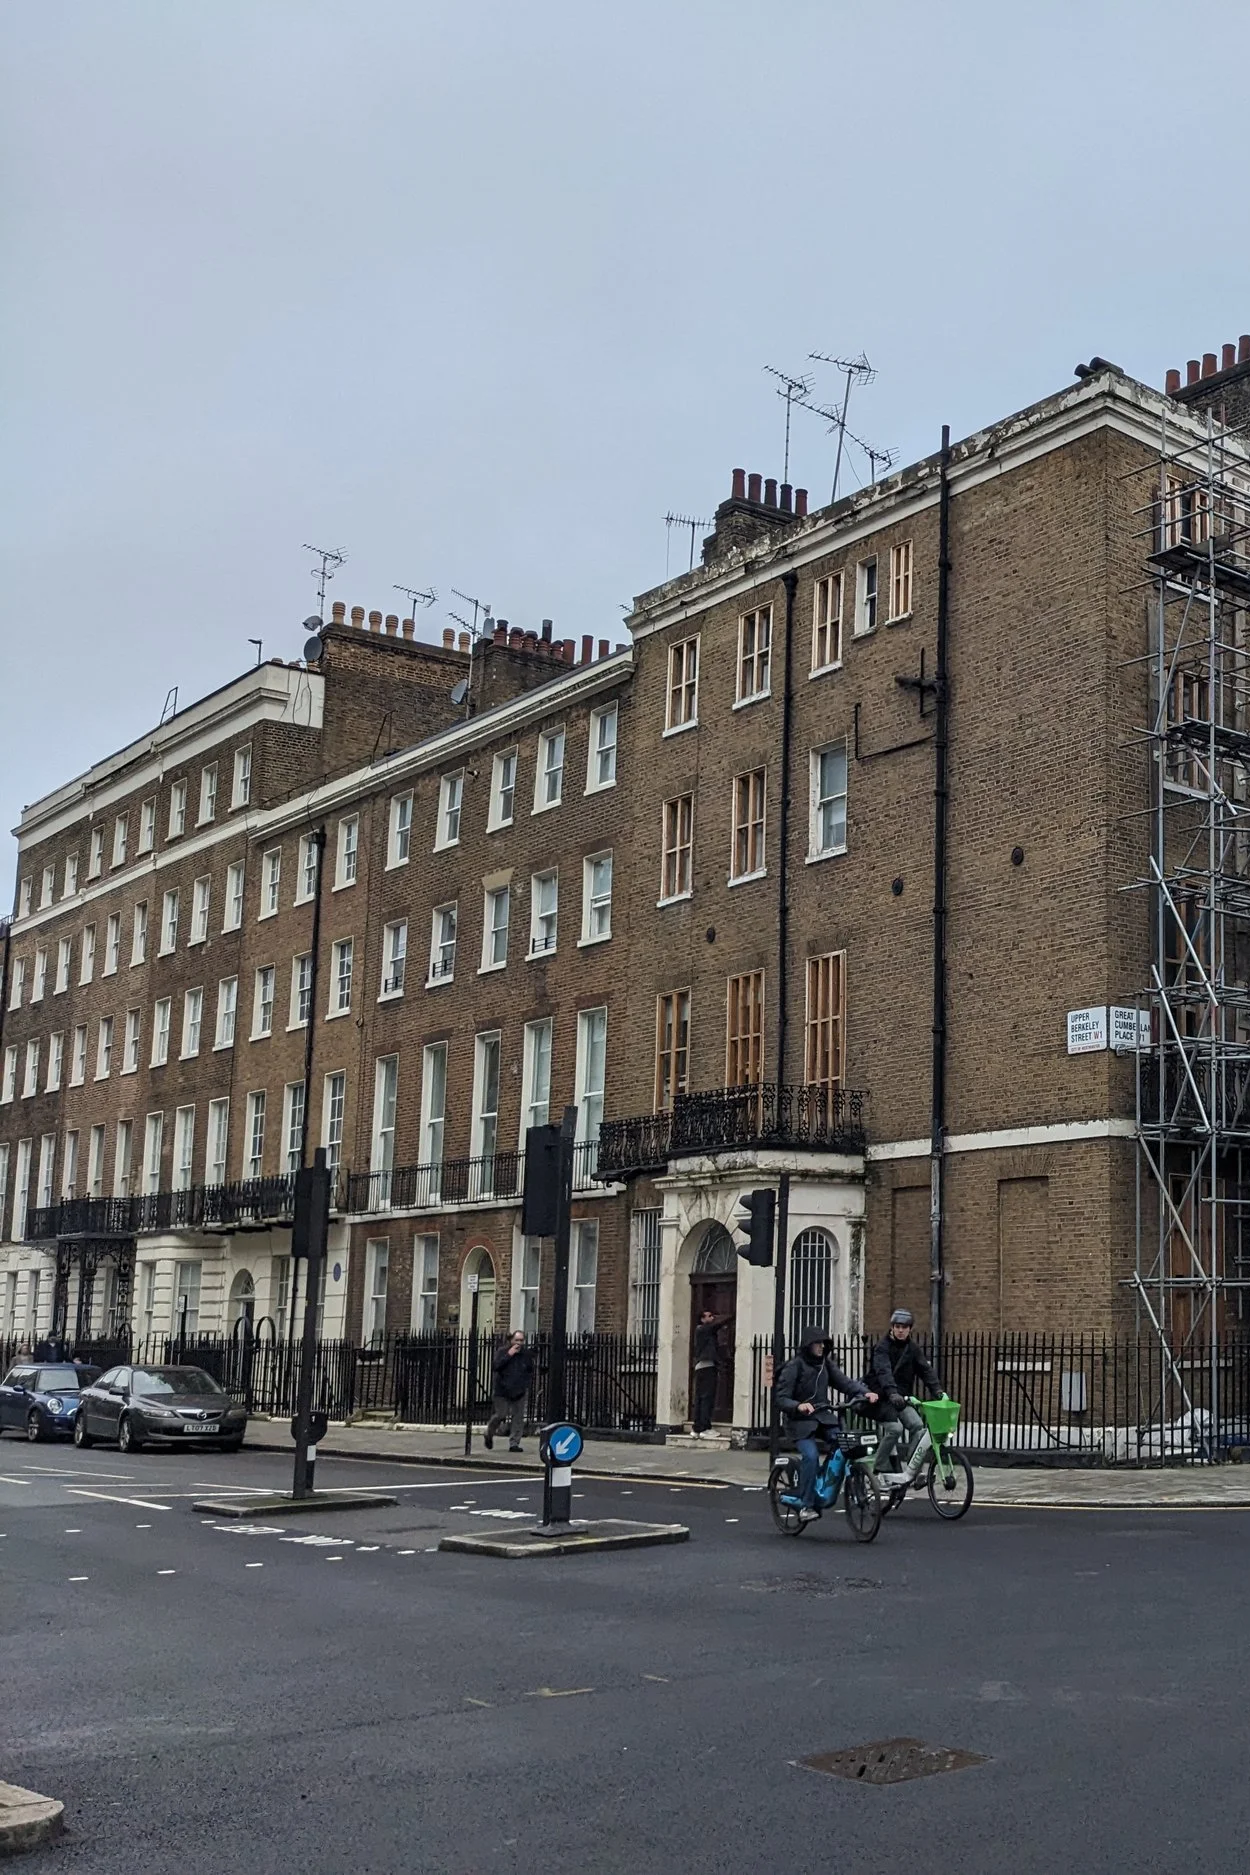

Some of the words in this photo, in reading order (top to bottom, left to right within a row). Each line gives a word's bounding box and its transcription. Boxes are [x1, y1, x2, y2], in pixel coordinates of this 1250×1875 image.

[1071, 1012, 1090, 1023] UPPER
[1114, 1010, 1134, 1021] GREAT
[1071, 1021, 1100, 1033] BERKELEY
[1071, 1032, 1092, 1043] STREET
[1093, 1030, 1103, 1040] W1
[1114, 1030, 1134, 1041] PLACE
